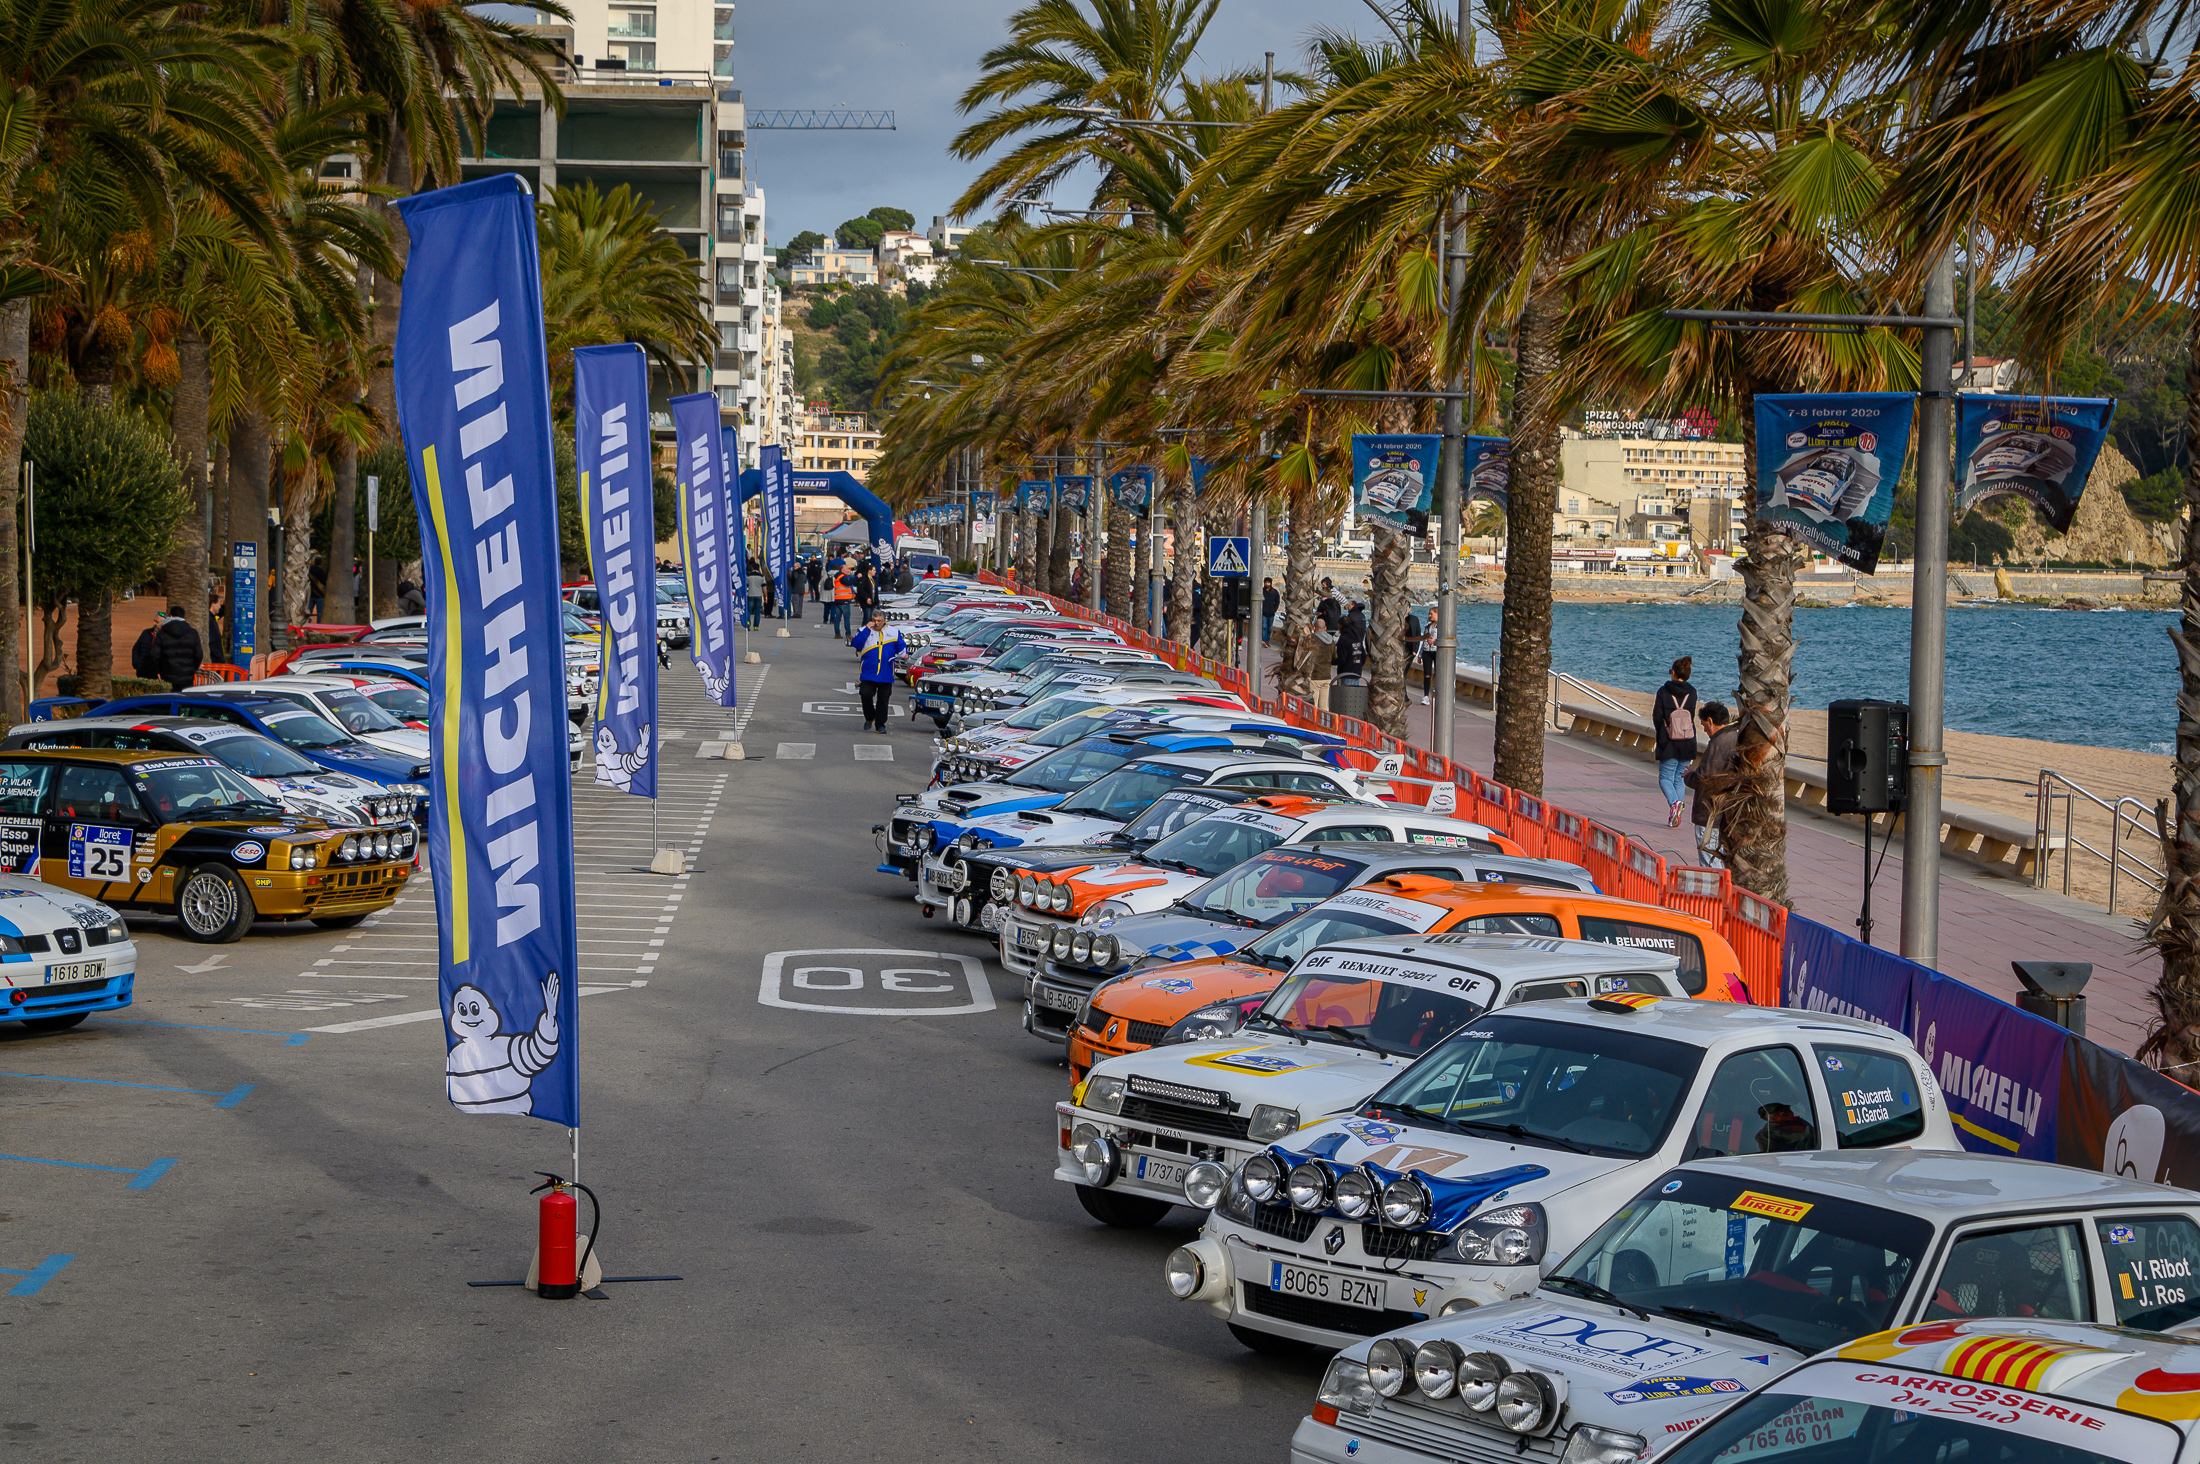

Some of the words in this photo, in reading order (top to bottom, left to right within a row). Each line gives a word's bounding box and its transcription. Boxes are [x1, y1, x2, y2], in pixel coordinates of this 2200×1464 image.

[815, 406, 830, 416] SPA
[1589, 411, 1620, 420] PIZZA
[1788, 408, 1808, 418] 7-8
[1811, 408, 1848, 418] febrer
[1850, 408, 1881, 418] 2020
[1589, 421, 1646, 430] POMODORO
[1822, 427, 1846, 435] lloret
[1807, 436, 1831, 447] LLORET
[1832, 437, 1842, 447] DE
[1842, 436, 1858, 448] MAR
[792, 480, 828, 488] CHELIN
[1800, 477, 1827, 489] MOTUL
[766, 465, 781, 579] MICHELIN
[1361, 513, 1417, 532] www.rallylloret.com
[691, 432, 728, 654] MICHELIN
[1771, 518, 1861, 561] www.rallylloret.com
[600, 402, 640, 716] MICHELIN
[449, 298, 541, 948] MICHELIN
[10, 778, 33, 787] VILAR
[7, 788, 41, 797] MENACHO
[902, 808, 941, 820] SUBARU
[1, 828, 29, 840] Esso
[99, 828, 122, 840] lloret
[1, 841, 35, 855] Super
[0, 855, 17, 867] Oil
[90, 847, 124, 877] 25
[1259, 852, 1296, 864] TALLER
[256, 878, 272, 887] OMP
[302, 885, 335, 894] MICHELIN
[1615, 936, 1676, 949] BELMONTE
[54, 964, 79, 981] 1618
[83, 961, 103, 979] BDW
[1306, 955, 1333, 969] elf
[1337, 960, 1399, 976] RENAULT
[1398, 969, 1438, 982] sport
[1447, 976, 1481, 993] elf
[1849, 1086, 1894, 1107] D.Sucarrat
[1939, 1051, 2042, 1138] MICHELIN
[1855, 1104, 1890, 1125] J.Garcia
[1147, 1161, 1174, 1181] 1737
[1738, 1194, 1804, 1217] PIRELLI
[2130, 1260, 2149, 1282] V.
[2149, 1257, 2192, 1281] Ribot
[1283, 1268, 1329, 1297] 8065
[1340, 1279, 1379, 1307] BZN
[2138, 1286, 2154, 1308] J.
[2154, 1284, 2187, 1305] Ros
[1642, 1387, 1680, 1400] LLORET
[1679, 1388, 1692, 1398] DE
[1692, 1384, 1716, 1396] MAR
[1662, 1382, 1681, 1391] 8
[1854, 1373, 2107, 1431] CARROSSERIE
[1890, 1390, 1932, 1407] du
[1927, 1400, 2021, 1425] Sud
[1745, 1428, 1779, 1451] 765
[1784, 1427, 1807, 1446] 46
[1811, 1421, 1832, 1442] 01
